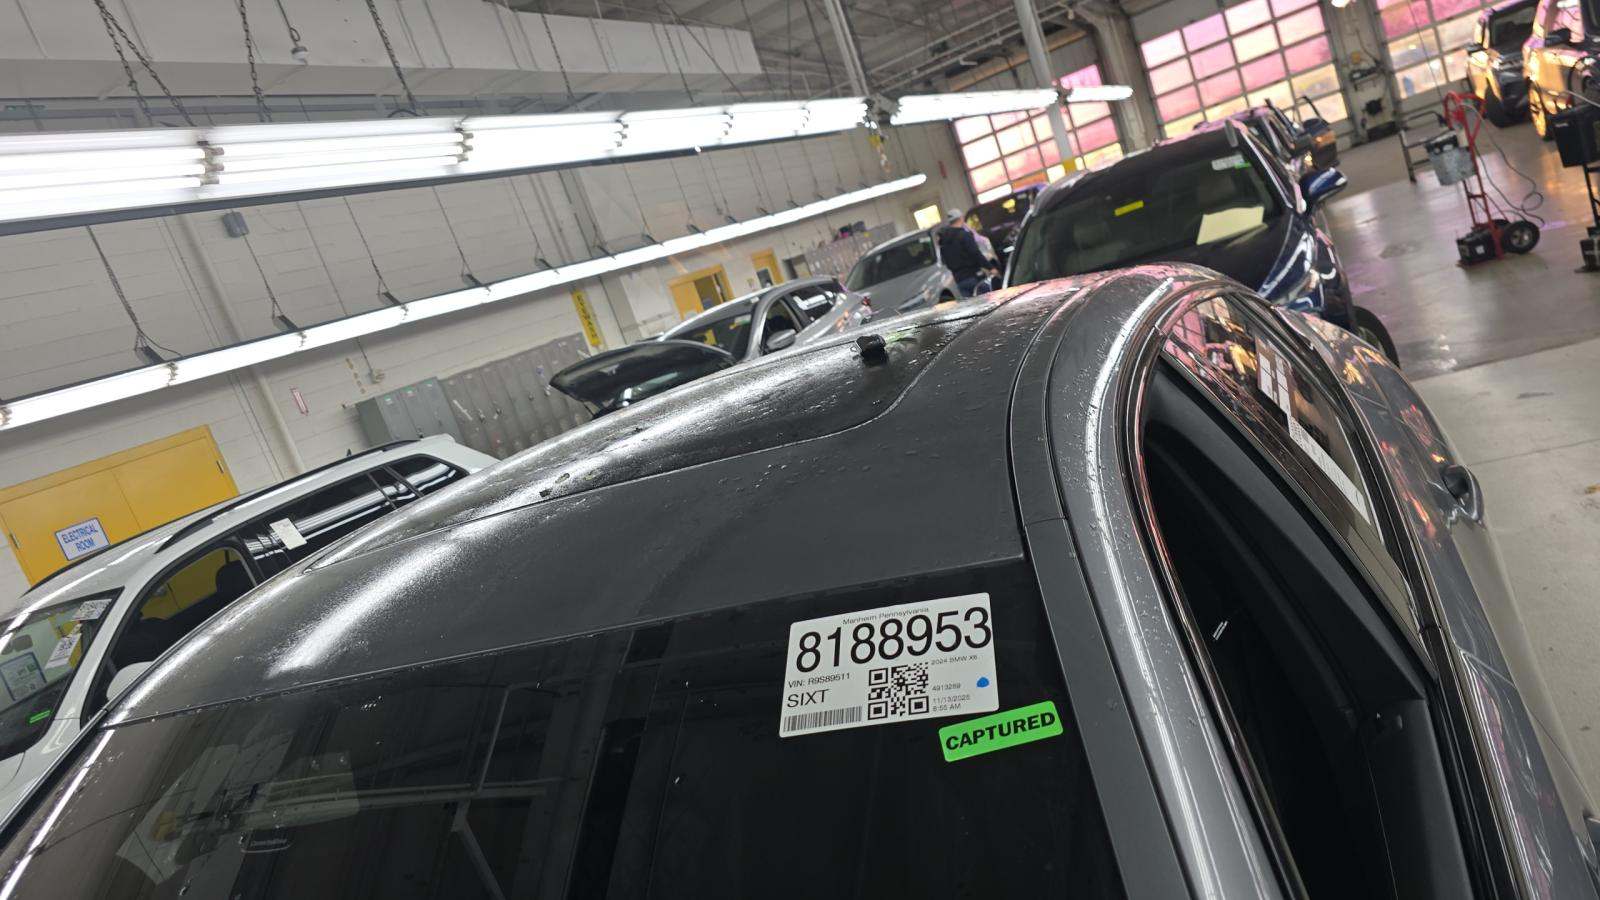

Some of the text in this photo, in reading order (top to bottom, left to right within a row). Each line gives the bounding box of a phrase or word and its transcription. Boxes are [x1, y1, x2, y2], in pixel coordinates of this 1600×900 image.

[75, 537, 96, 552] ROOM
[796, 606, 992, 673] 8188953
[788, 679, 805, 688] VIN:
[787, 688, 829, 708] SIXT
[945, 711, 1056, 751] CAPTURED
